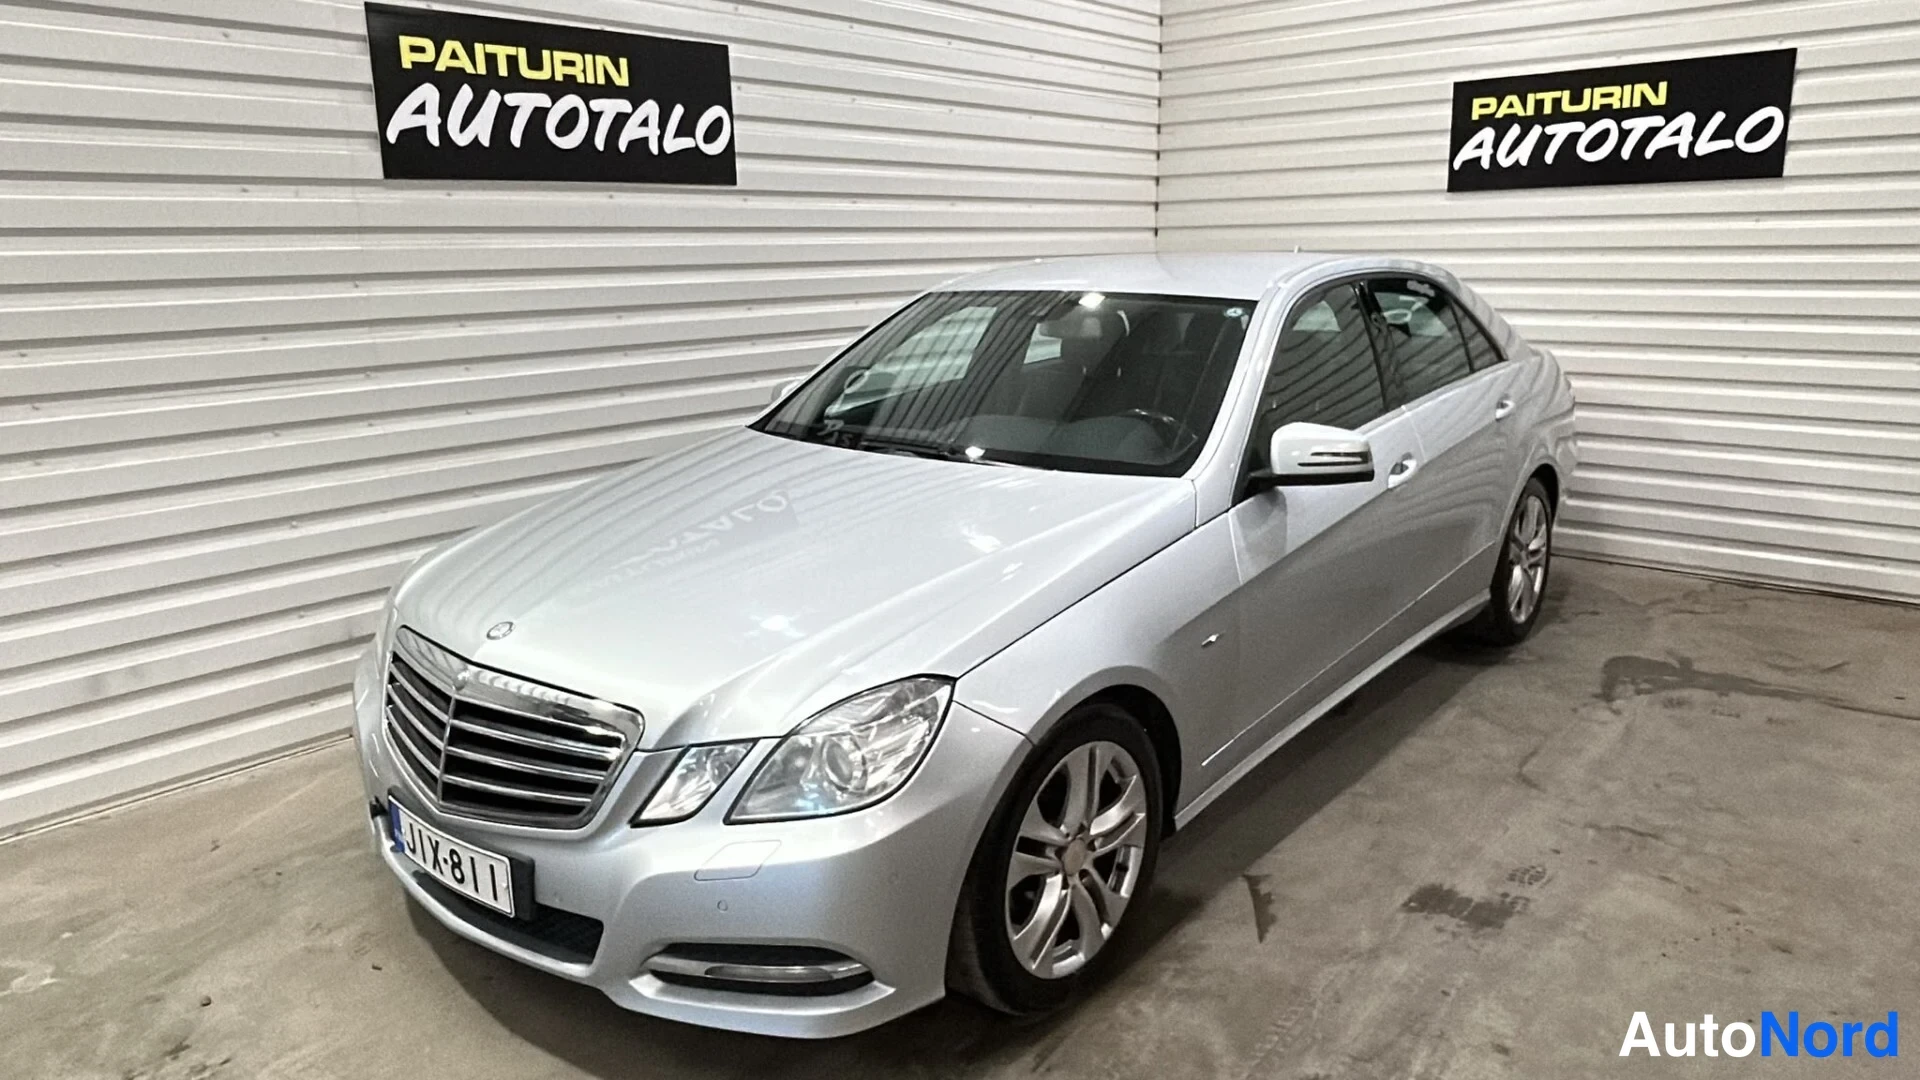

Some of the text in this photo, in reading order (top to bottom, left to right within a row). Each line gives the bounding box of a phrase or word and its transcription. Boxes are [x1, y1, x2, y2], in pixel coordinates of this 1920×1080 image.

[399, 35, 629, 87] PAITURIN
[386, 82, 731, 156] AUTOTALO
[1471, 81, 1668, 120] PAITURIN
[1453, 106, 1785, 171] AUTOTALO
[406, 822, 498, 902] JIX-811
